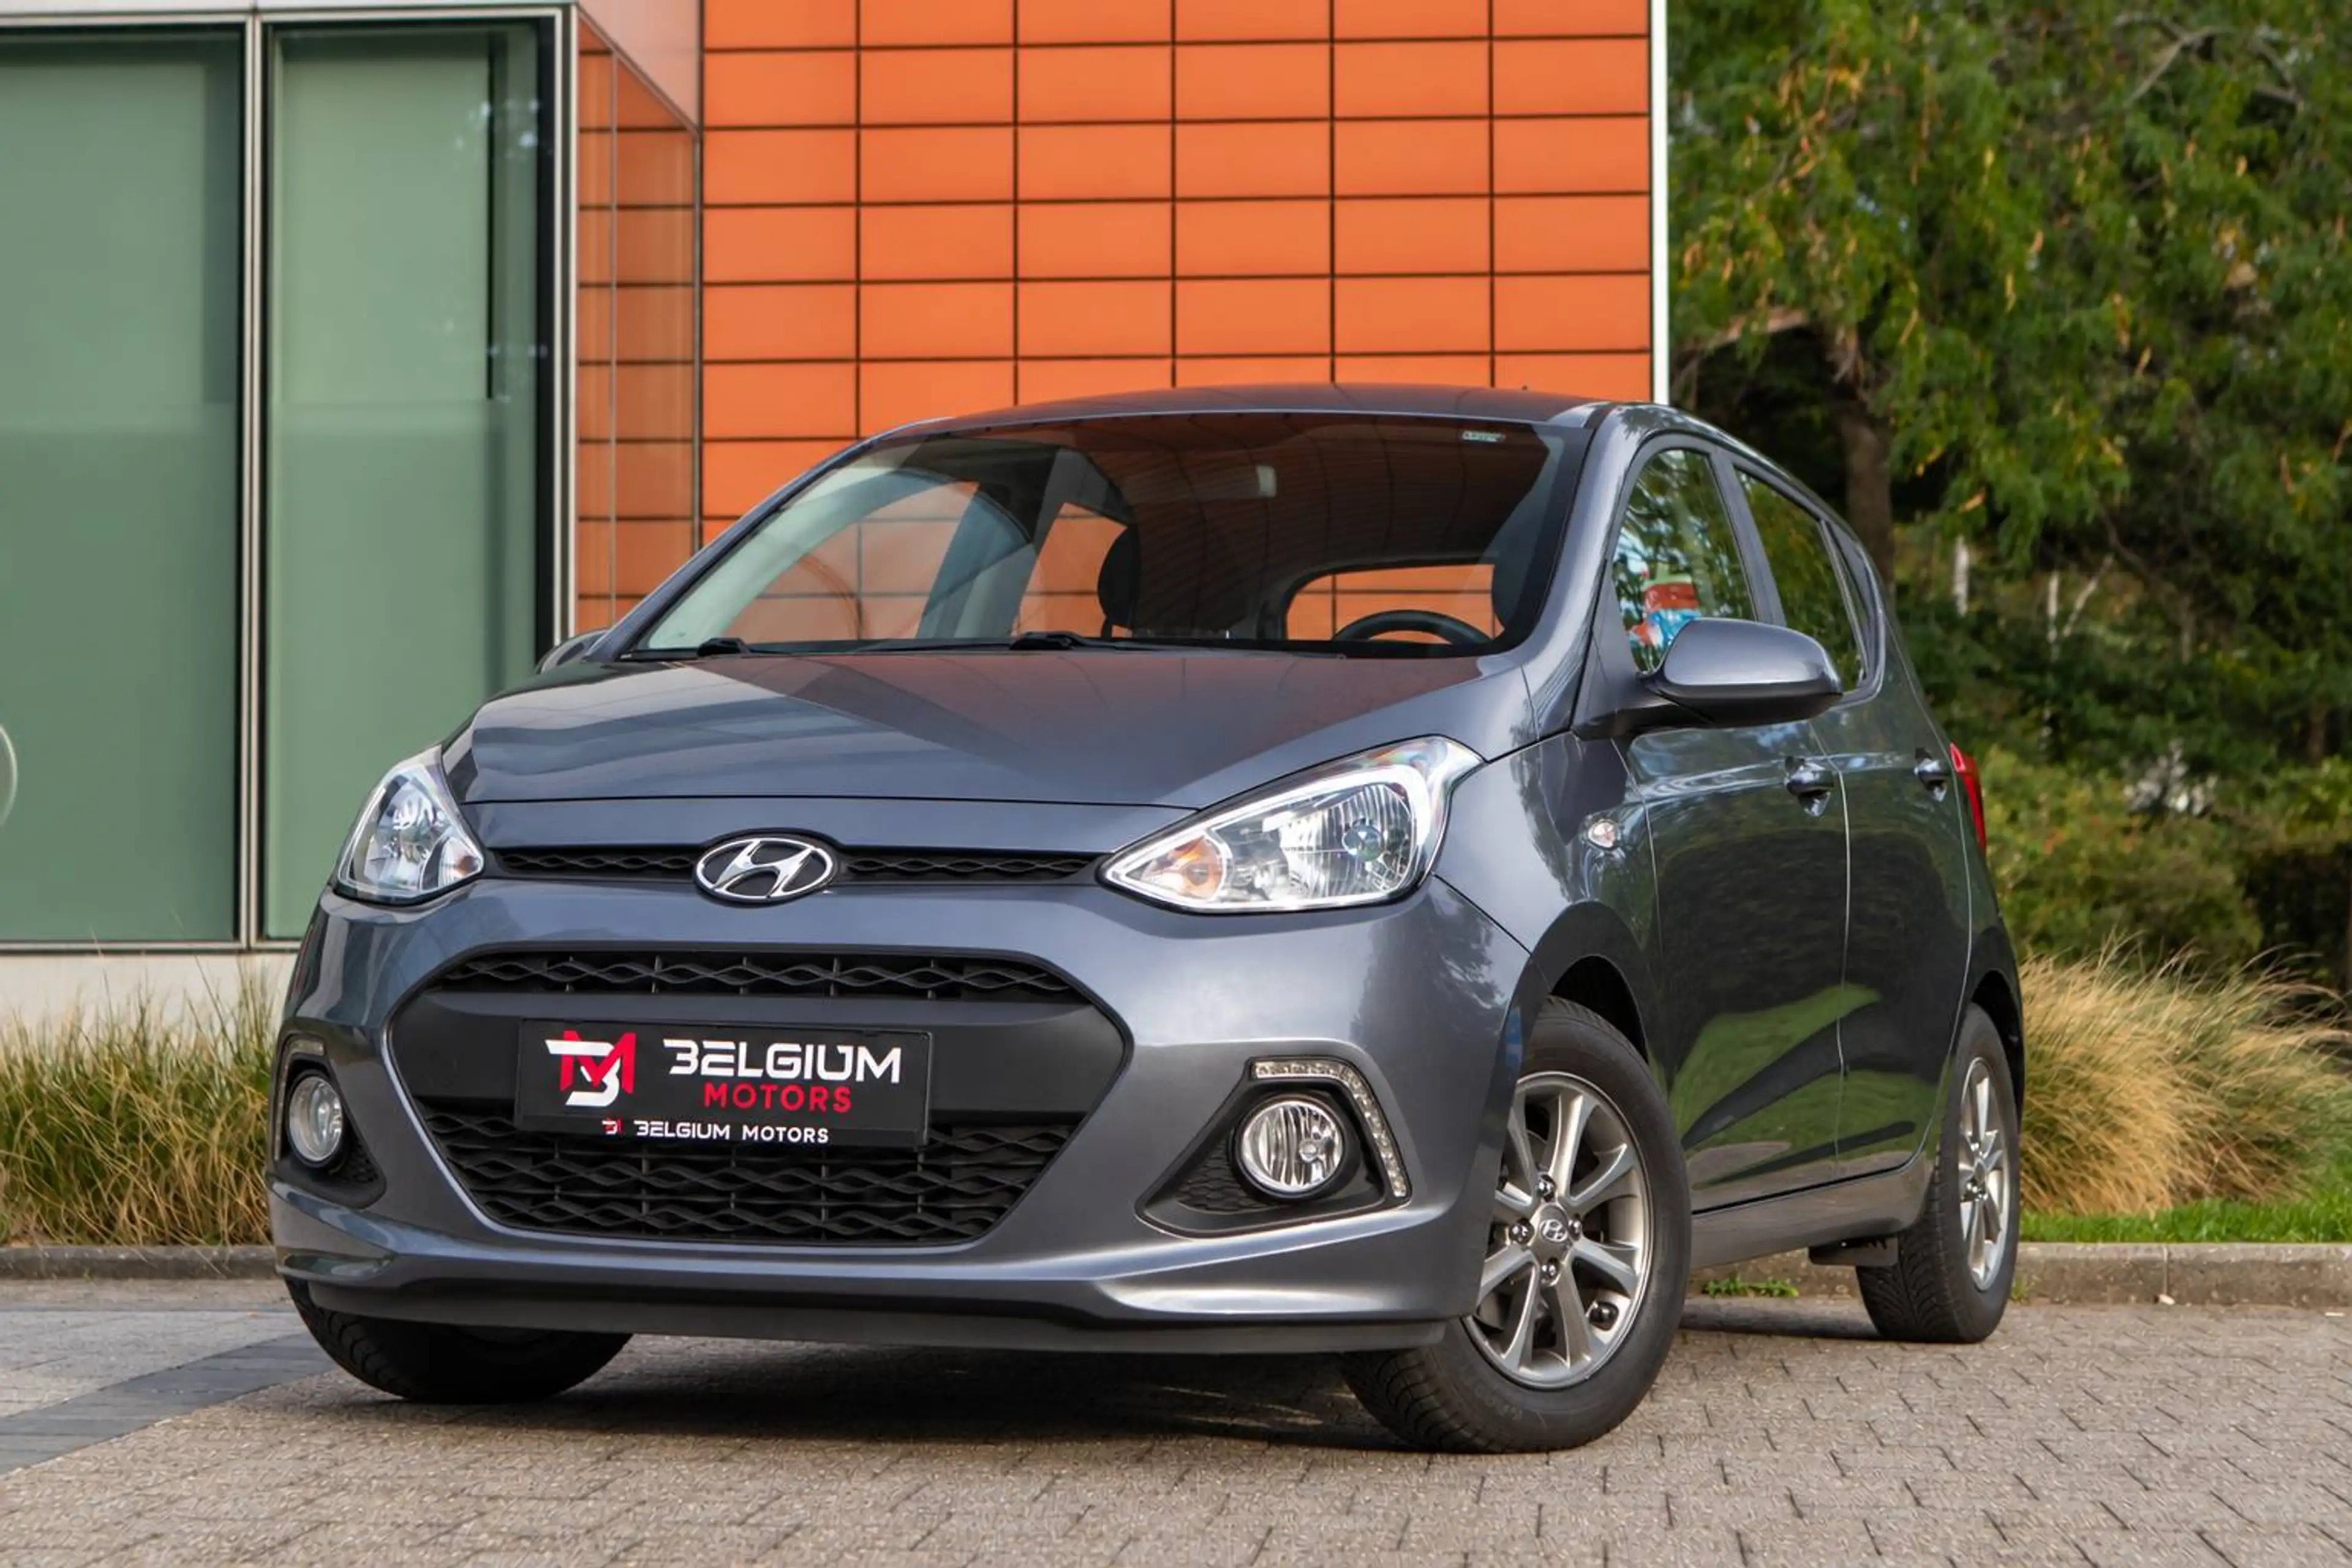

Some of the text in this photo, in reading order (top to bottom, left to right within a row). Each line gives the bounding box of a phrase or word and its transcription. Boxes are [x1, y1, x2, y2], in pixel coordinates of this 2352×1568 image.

[663, 1038, 902, 1084] BELGIUM
[703, 1081, 853, 1114] MOTORS
[633, 1120, 731, 1140] BELGIUM
[742, 1125, 829, 1144] MOTORS
